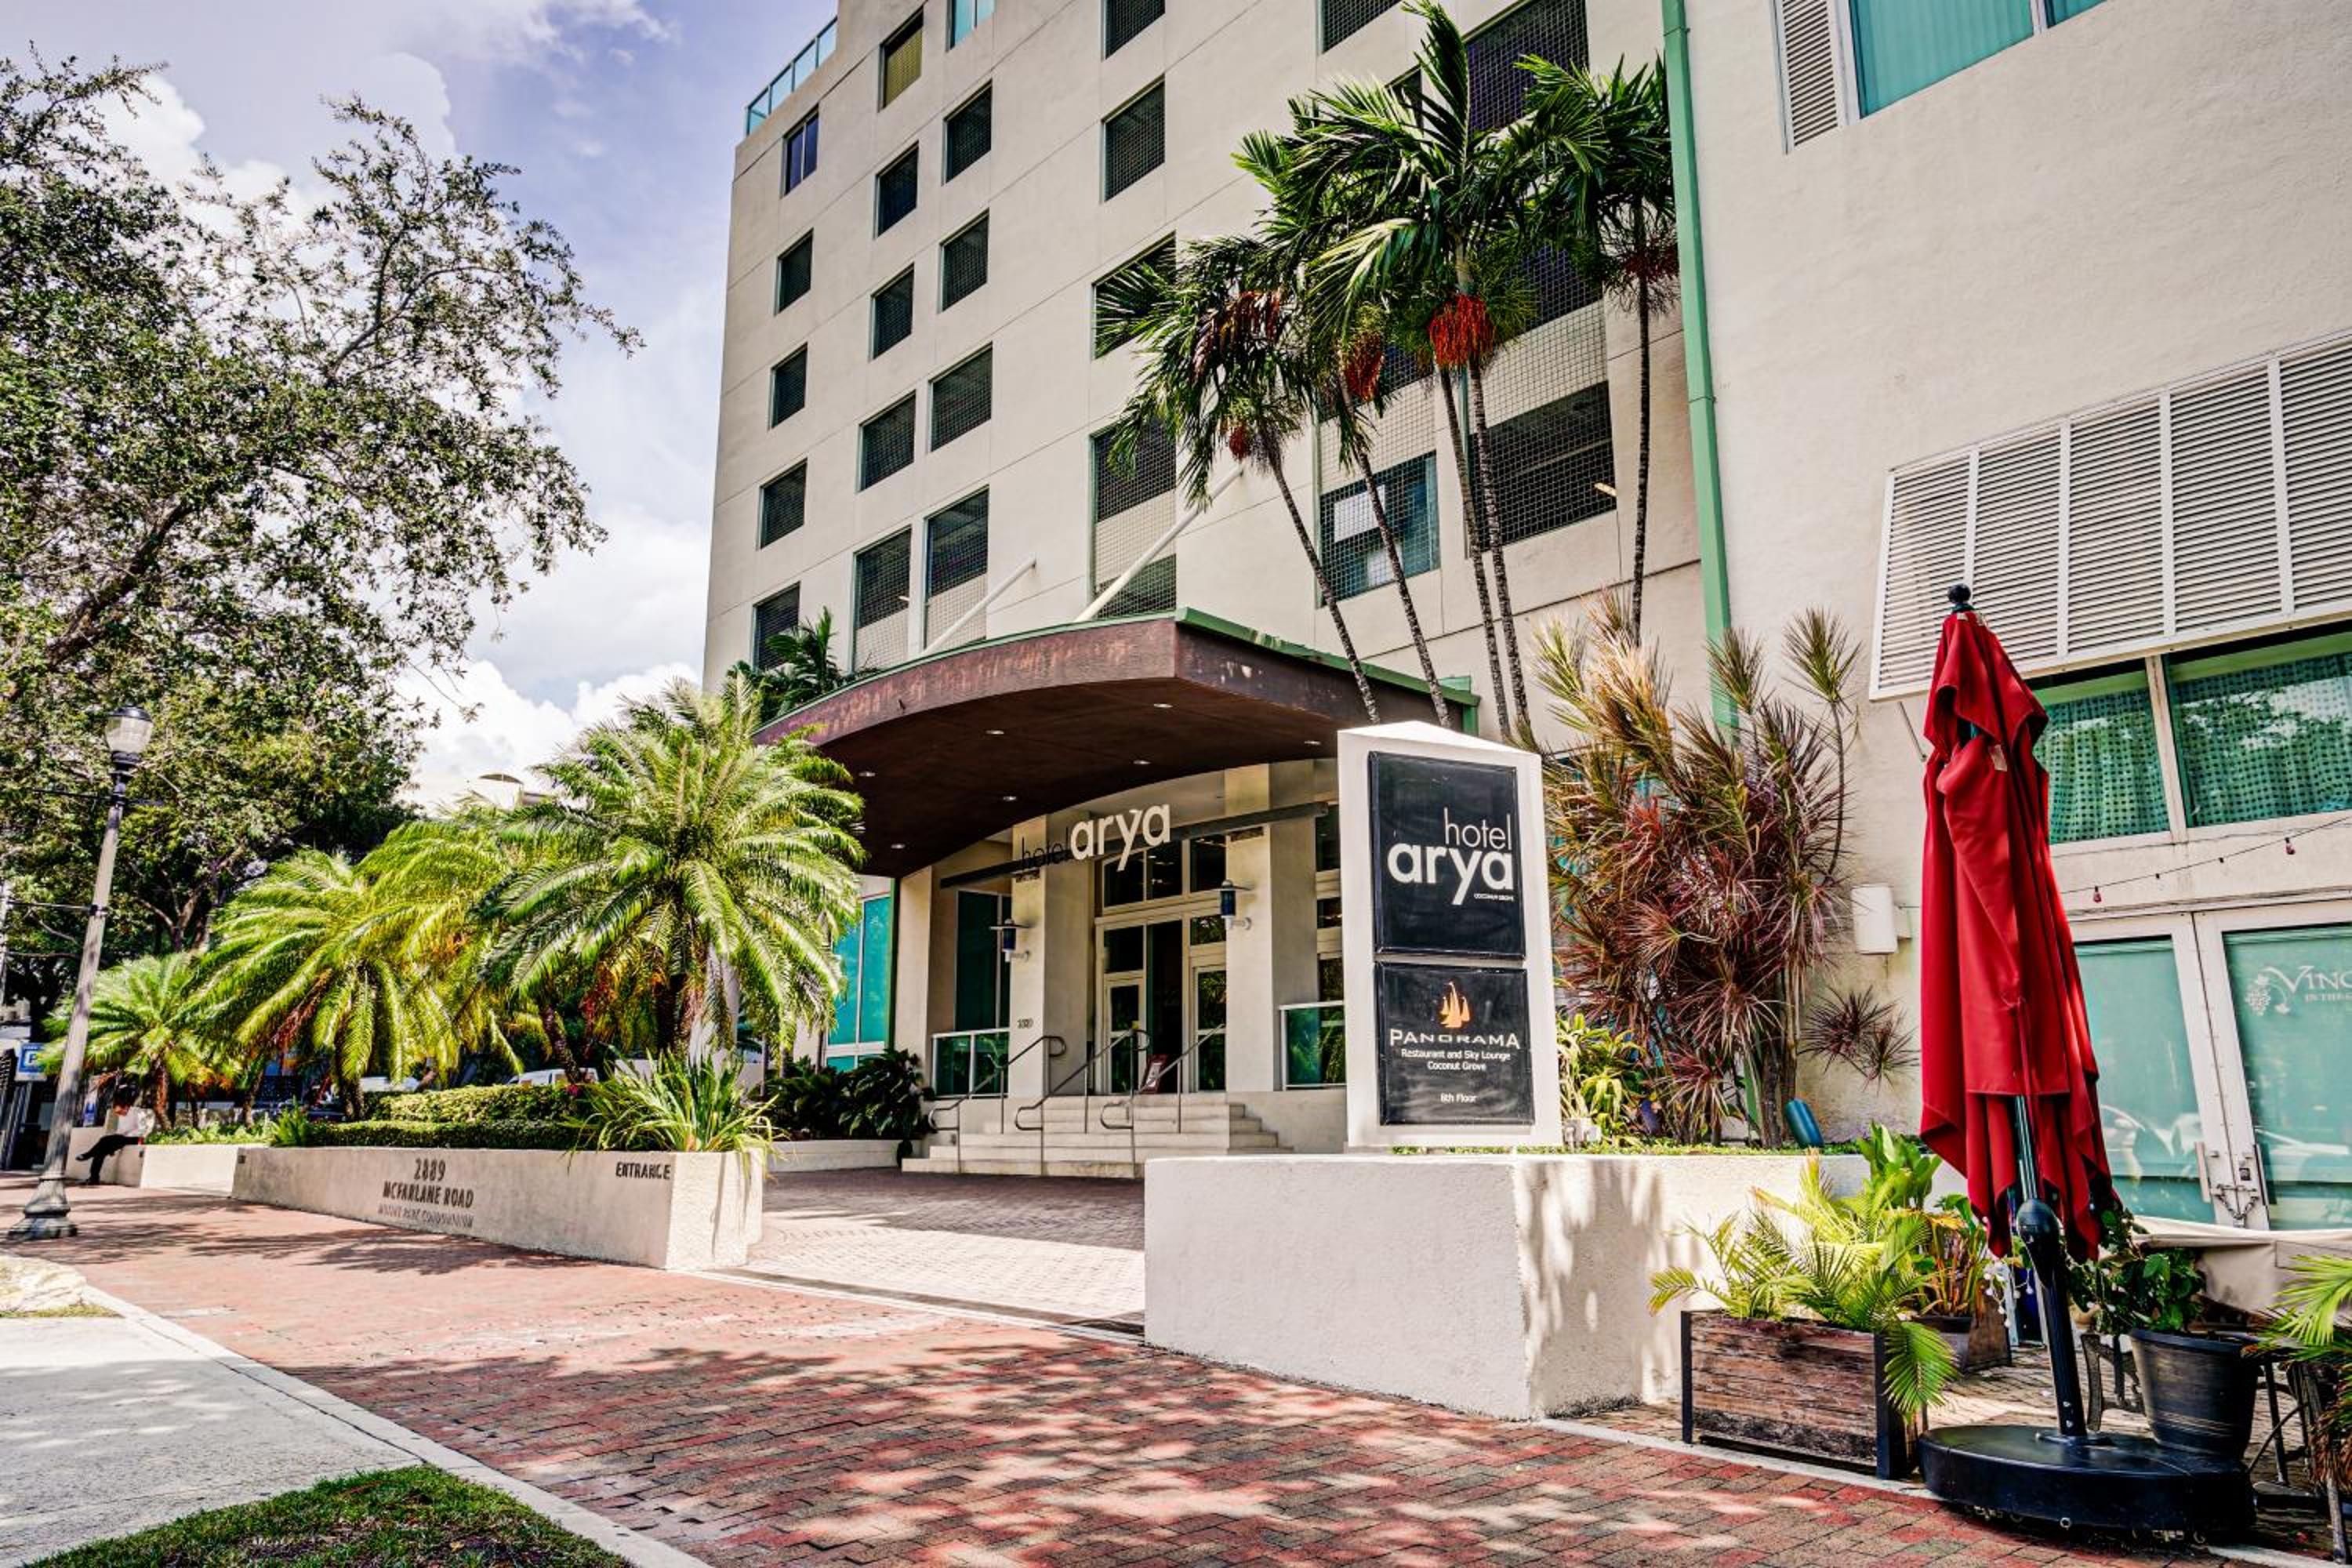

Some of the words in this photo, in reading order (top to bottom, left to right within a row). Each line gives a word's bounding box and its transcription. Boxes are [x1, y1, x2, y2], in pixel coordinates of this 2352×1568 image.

[1070, 804, 1171, 872] arya
[1444, 807, 1512, 851] hotel
[1387, 842, 1514, 906] arya
[1390, 1029, 1521, 1050] PANORAMA
[1401, 1048, 1445, 1058] Restaurant
[1446, 1050, 1462, 1059] and
[1464, 1051, 1479, 1061] Sky
[1481, 1051, 1511, 1062] Lounge
[1427, 1061, 1461, 1071] Coconut
[1462, 1062, 1487, 1072] Grove
[414, 1157, 446, 1182] 2889
[615, 1161, 671, 1180] ENTRANCE
[382, 1181, 441, 1204] MCFARLANE
[443, 1188, 474, 1208] ROAD
